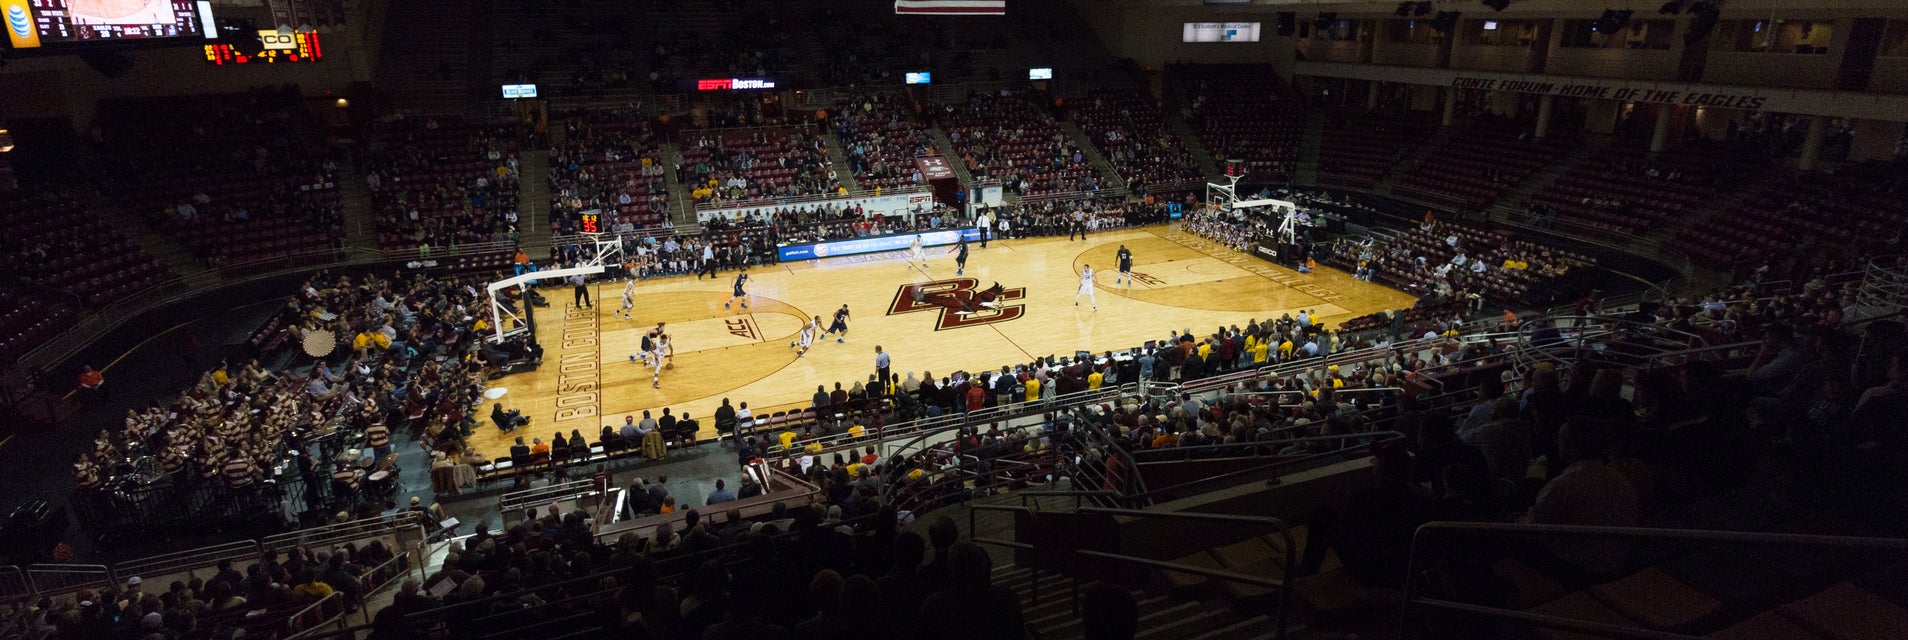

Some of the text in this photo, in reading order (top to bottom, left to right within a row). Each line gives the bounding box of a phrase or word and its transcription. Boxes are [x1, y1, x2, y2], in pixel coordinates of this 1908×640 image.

[1452, 76, 1498, 90] CONTE
[1499, 79, 1554, 94] FORUM
[1559, 84, 1612, 98] HOME
[1612, 87, 1642, 99] OF
[1643, 89, 1682, 103] THE
[1682, 92, 1767, 109] EAGLES
[909, 195, 931, 204] ESPN
[584, 221, 597, 232] 35
[725, 318, 757, 340] ACC
[554, 350, 598, 422] BOSTON
